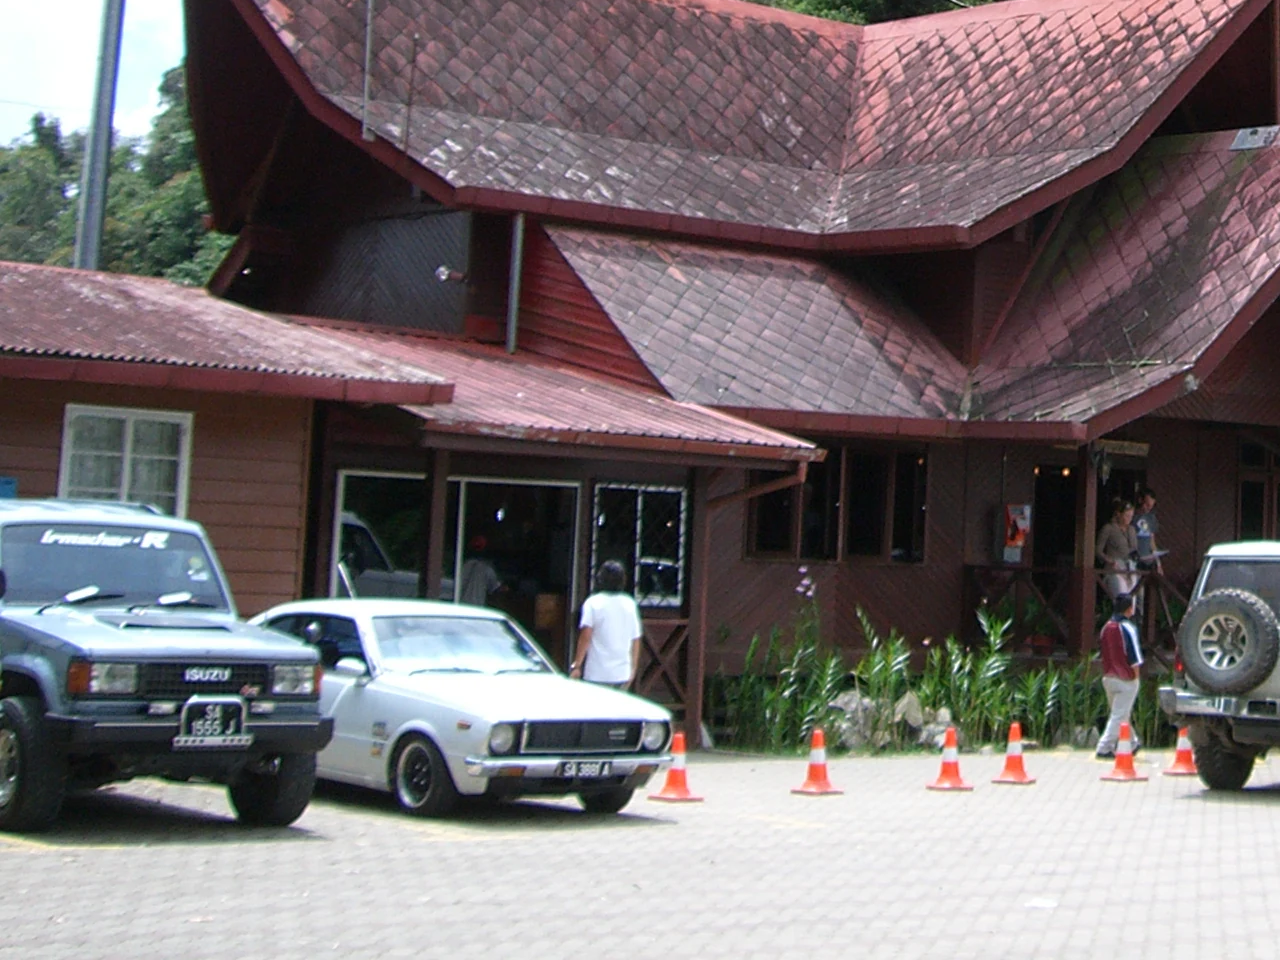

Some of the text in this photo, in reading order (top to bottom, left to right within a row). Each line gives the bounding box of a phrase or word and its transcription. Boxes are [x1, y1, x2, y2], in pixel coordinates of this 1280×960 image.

[184, 667, 232, 682] ISUZU
[205, 705, 223, 720] SA
[191, 719, 237, 736] 1555 J
[563, 762, 577, 777] SA
[601, 762, 611, 777] A
